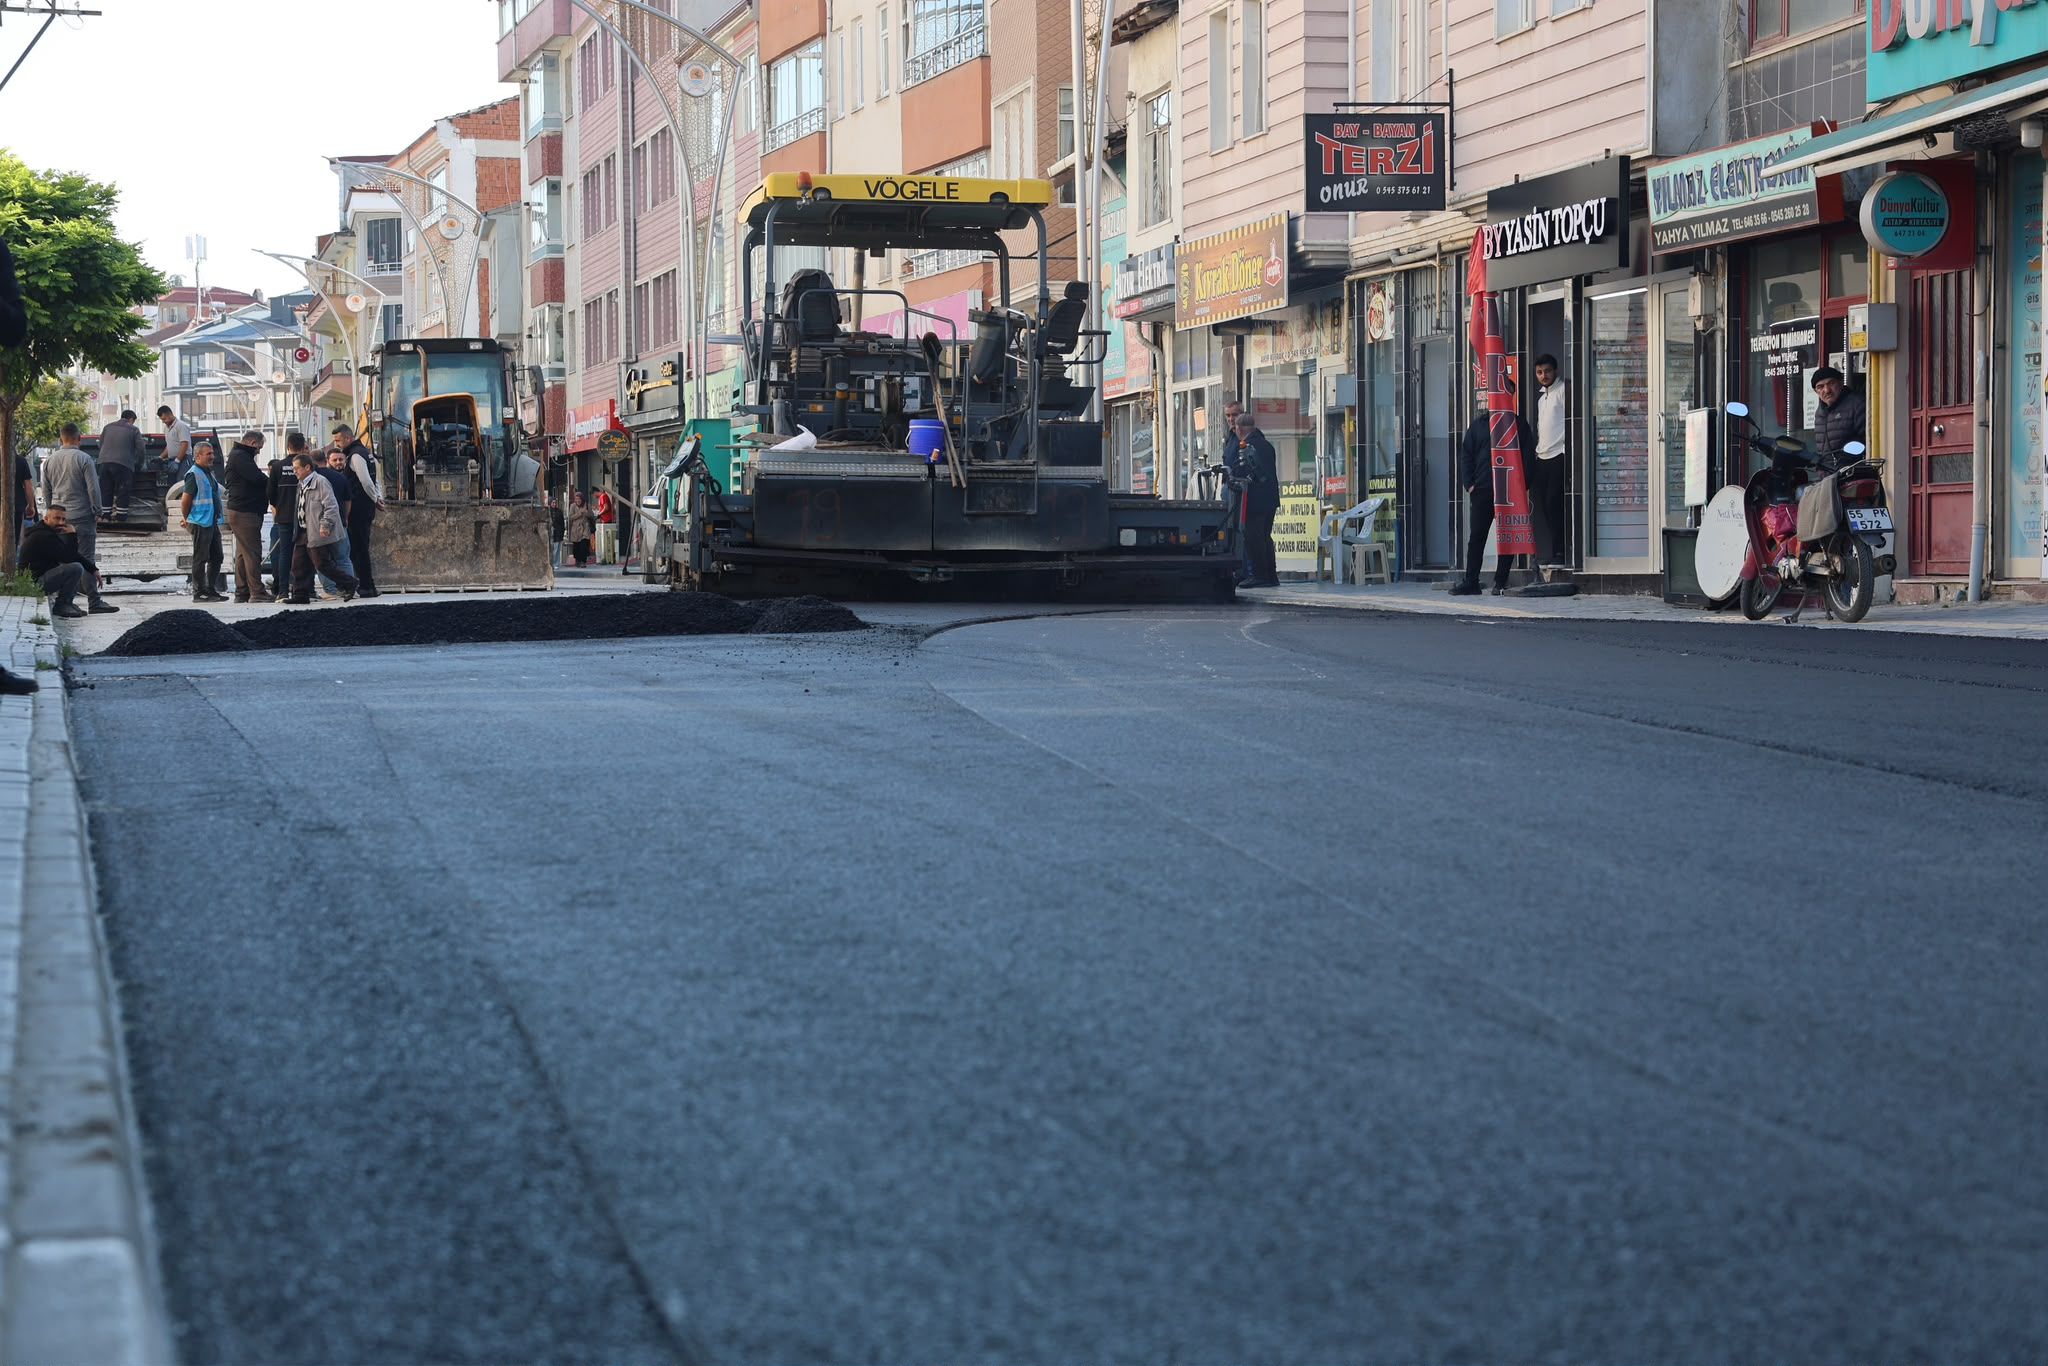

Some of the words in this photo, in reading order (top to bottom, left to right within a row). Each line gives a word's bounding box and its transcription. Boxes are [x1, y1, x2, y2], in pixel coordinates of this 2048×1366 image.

[1334, 123, 1360, 138] BAY
[1373, 123, 1415, 138] BAYAN
[1315, 121, 1434, 174] TERZİ
[864, 176, 960, 200] VÖGELE
[1382, 186, 1395, 195] 545
[1397, 186, 1410, 195] 375
[1411, 186, 1420, 195] 61
[1422, 186, 1431, 195] 21
[1880, 196, 1940, 216] DünyaKültür
[1483, 224, 1505, 260] BY
[1500, 206, 1551, 256] YASİN
[1552, 197, 1607, 245] TOPÇU
[1655, 227, 1689, 246] YAHYA
[1690, 217, 1729, 240] YILMAZ
[1731, 219, 1744, 232] TEL:
[1744, 216, 1754, 228] 646
[1753, 214, 1761, 226] 35
[1760, 212, 1768, 225] 66
[1771, 209, 1784, 223] 0545
[1784, 206, 1795, 220] 260
[1795, 204, 1802, 218] 25
[1802, 203, 1810, 216] 28
[1230, 248, 1263, 293] Döner
[1282, 480, 1313, 495] DÖNER
[1848, 510, 1863, 519] 55
[1872, 509, 1888, 518] PK
[1860, 520, 1882, 529] 572
